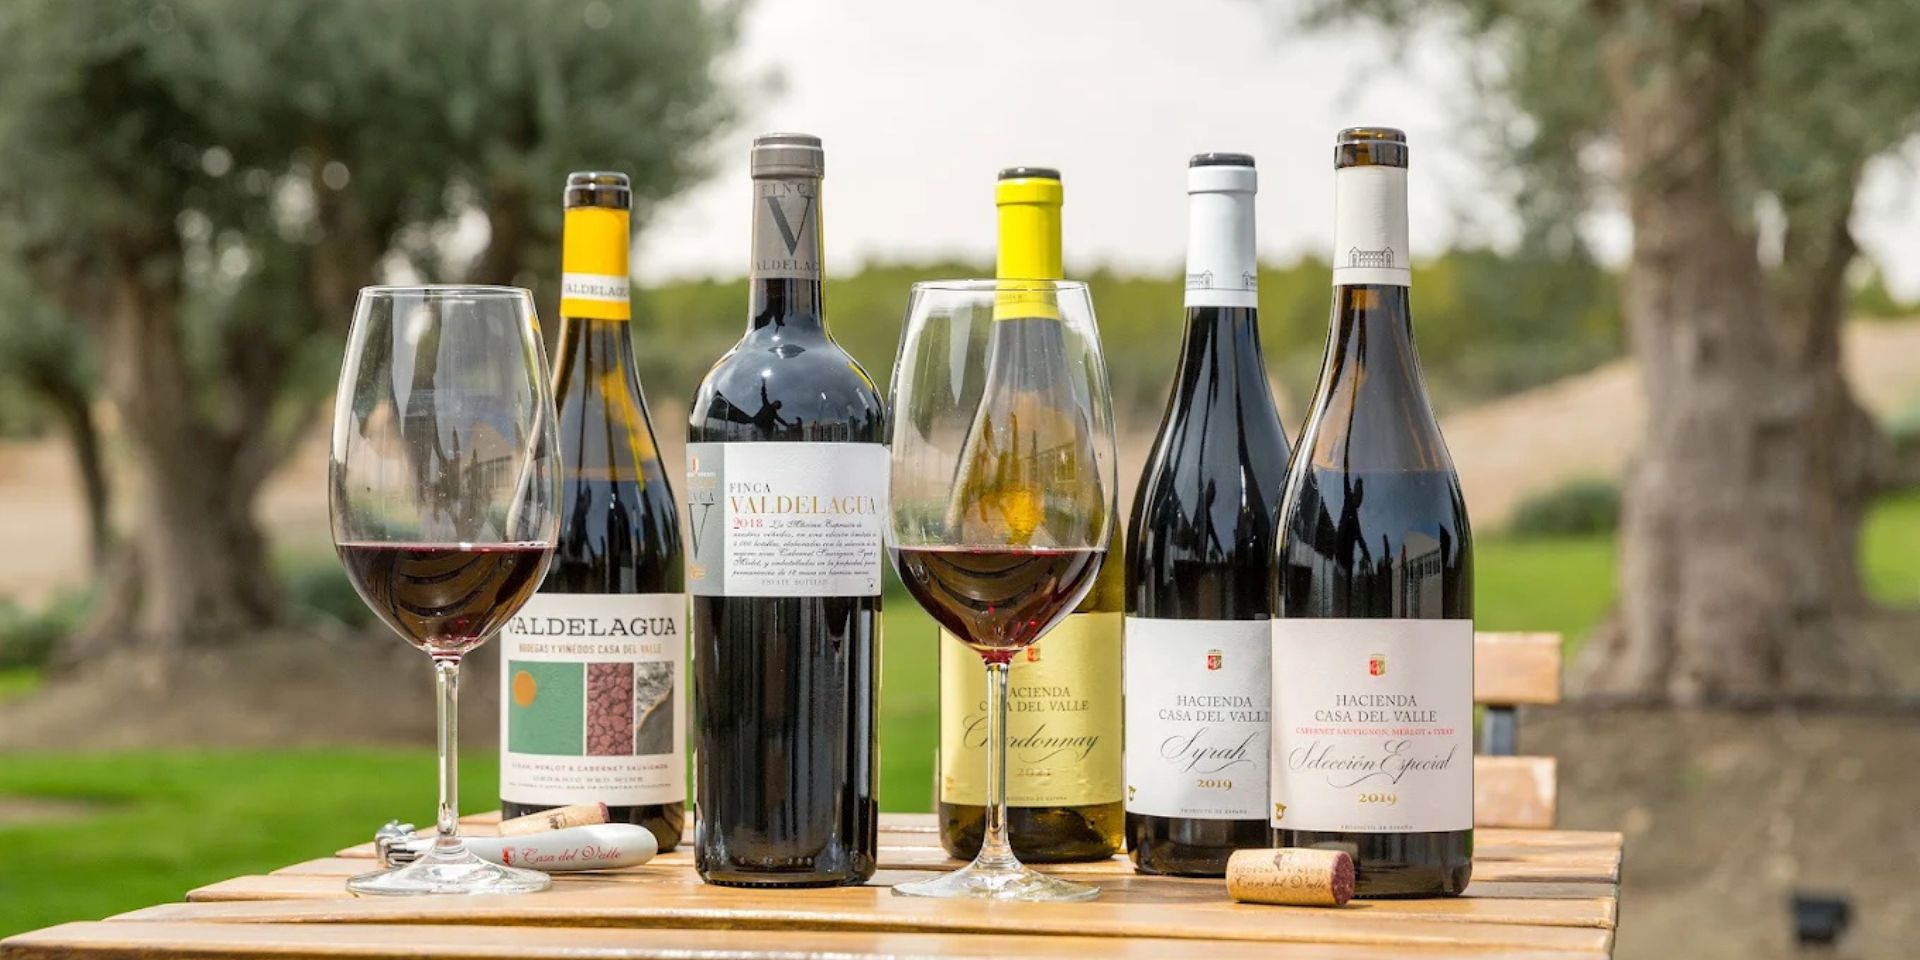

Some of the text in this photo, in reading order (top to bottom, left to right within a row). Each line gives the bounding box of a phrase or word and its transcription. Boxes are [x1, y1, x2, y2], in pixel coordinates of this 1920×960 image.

[762, 196, 816, 257] V
[756, 260, 818, 271] ALDELAG
[729, 482, 771, 493] FINCA
[730, 495, 876, 515] VALDELAGUA
[733, 517, 763, 529] 2018
[508, 616, 677, 636] VALDELAGUA
[598, 643, 620, 654] CASA
[623, 643, 637, 654] DEL
[1008, 687, 1071, 698] ACIENDA
[979, 701, 1089, 712] CA DEL VALLE
[1176, 695, 1253, 707] HACIENDA
[1336, 694, 1418, 707] HACIENDA
[1159, 709, 1191, 721] CASA
[1196, 711, 1224, 722] DEL
[1315, 711, 1437, 722] CASA DEL VALLE
[963, 715, 1099, 764] Crdonnay
[1160, 726, 1259, 774] Syrah
[1288, 741, 1375, 772] Selección
[1197, 779, 1233, 791] 2019
[1359, 793, 1397, 806] 2019
[522, 845, 622, 865] Casa del Valle
